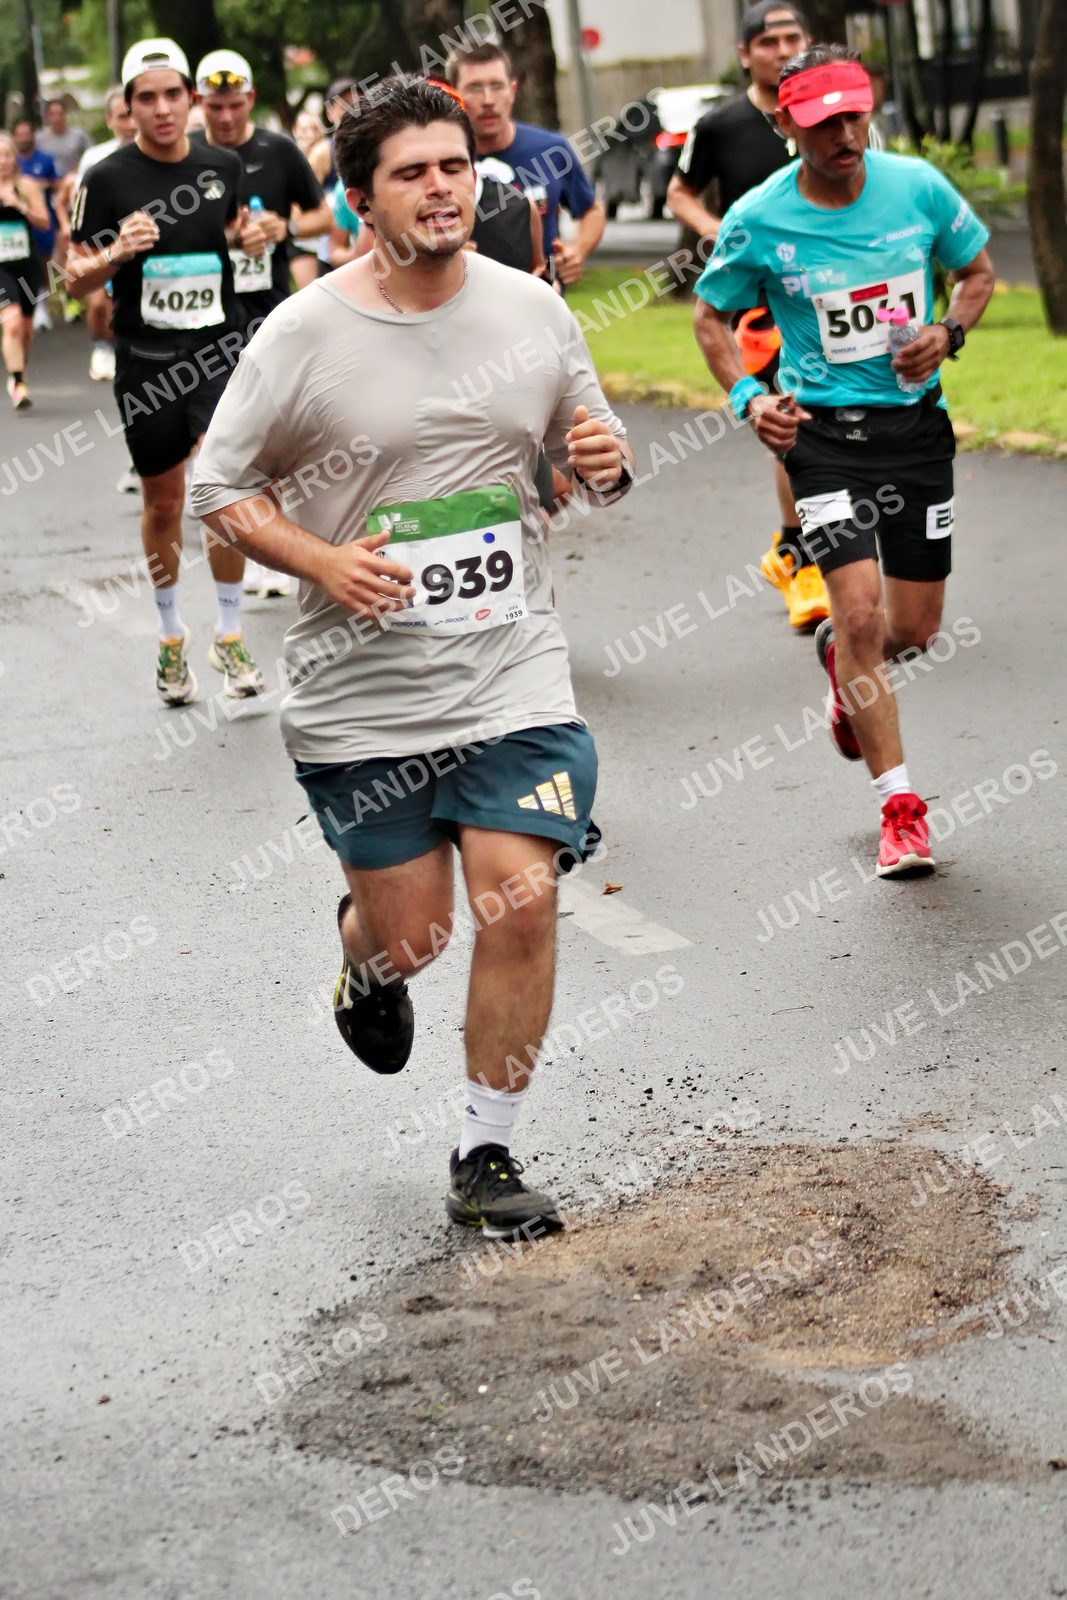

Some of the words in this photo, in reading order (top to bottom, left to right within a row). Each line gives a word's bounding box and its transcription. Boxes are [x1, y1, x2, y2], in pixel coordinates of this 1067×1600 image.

[149, 288, 214, 312] 4029
[398, 551, 514, 608] 939
[444, 615, 470, 624] BROOKS
[505, 610, 523, 621] 1939
